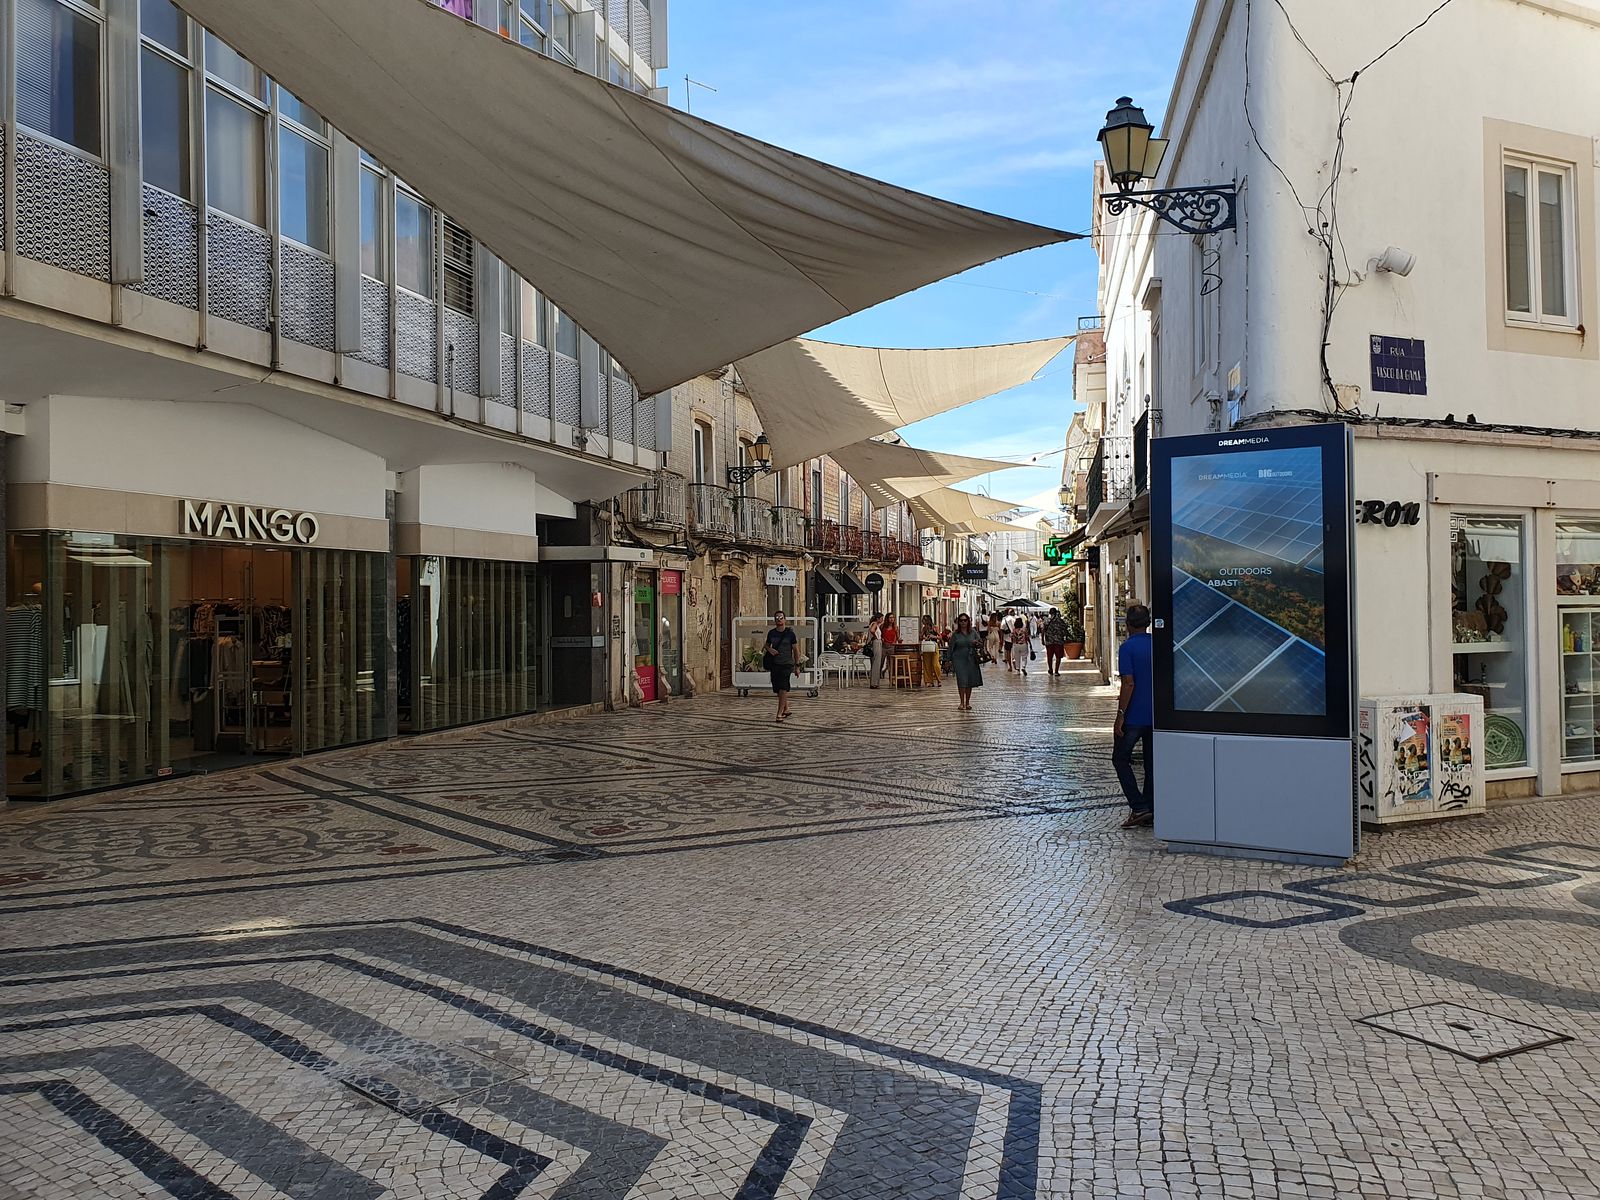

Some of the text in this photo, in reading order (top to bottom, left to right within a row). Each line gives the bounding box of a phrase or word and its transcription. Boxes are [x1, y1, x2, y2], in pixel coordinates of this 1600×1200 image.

[1389, 346, 1405, 357] RUA
[1376, 366, 1421, 381] VASCO DA GAMA
[1218, 436, 1269, 447] DREAMMEDIA
[1198, 471, 1247, 481] DREAMMEDIA
[181, 500, 319, 543] MANGO
[1219, 566, 1272, 577] OUTDOORS
